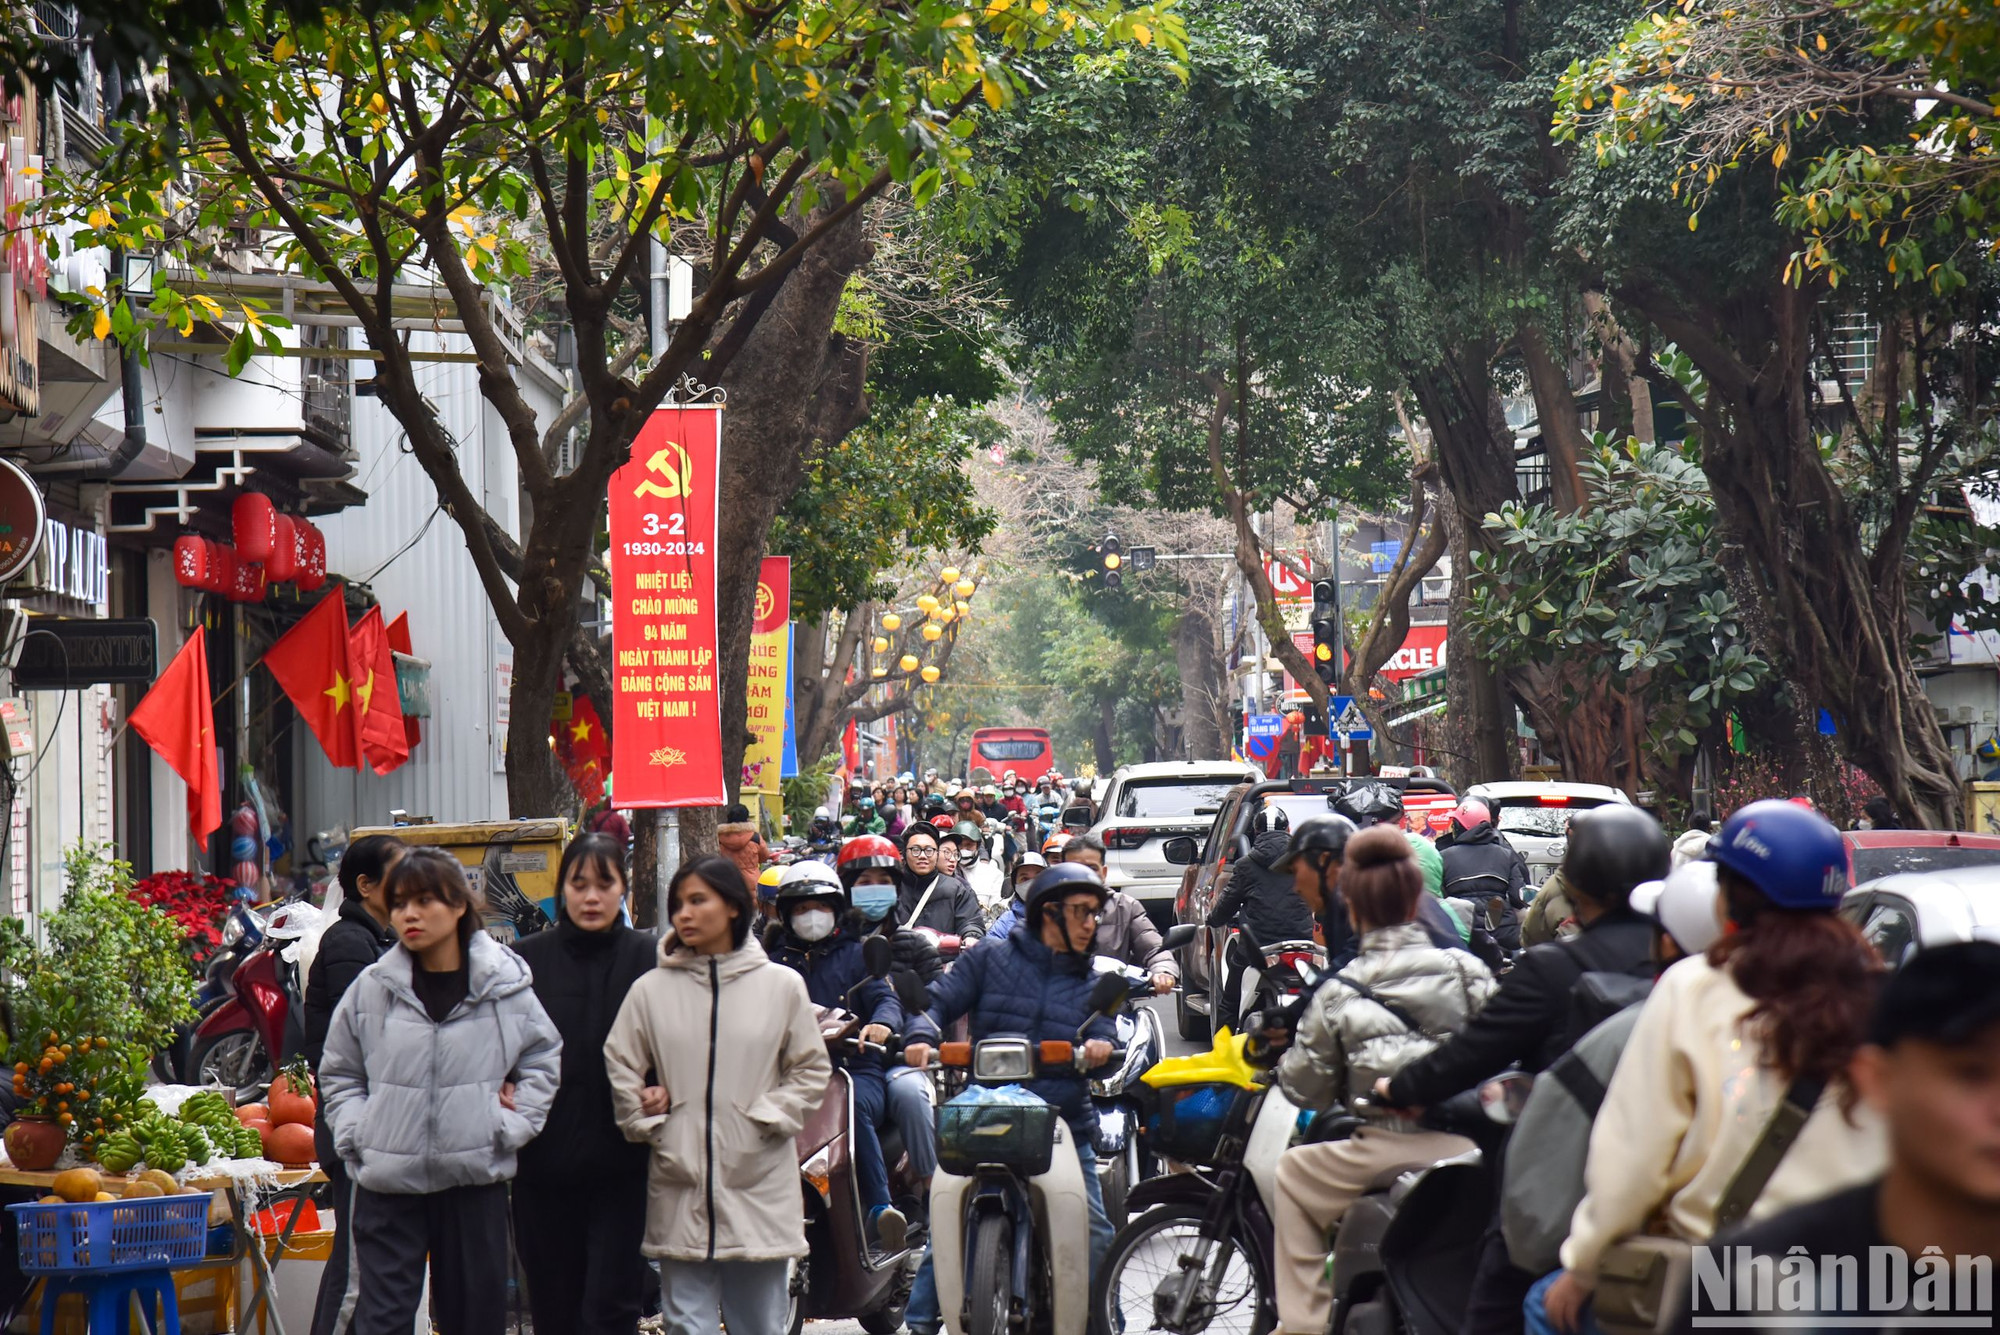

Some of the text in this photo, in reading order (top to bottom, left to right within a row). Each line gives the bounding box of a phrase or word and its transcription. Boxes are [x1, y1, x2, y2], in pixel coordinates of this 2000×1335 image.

[643, 513, 685, 535] 3-2
[623, 542, 705, 555] 1930-2024
[636, 569, 693, 592] NHIỆT LIỆT
[632, 595, 698, 615] CHÀO MỪNG
[644, 621, 687, 640] 94 NĂM
[619, 646, 712, 669] NGÀY THÀNH LẬP
[621, 669, 712, 695] ĐẢNG CỘNG SẢN
[637, 698, 697, 721] VIỆT NAM !
